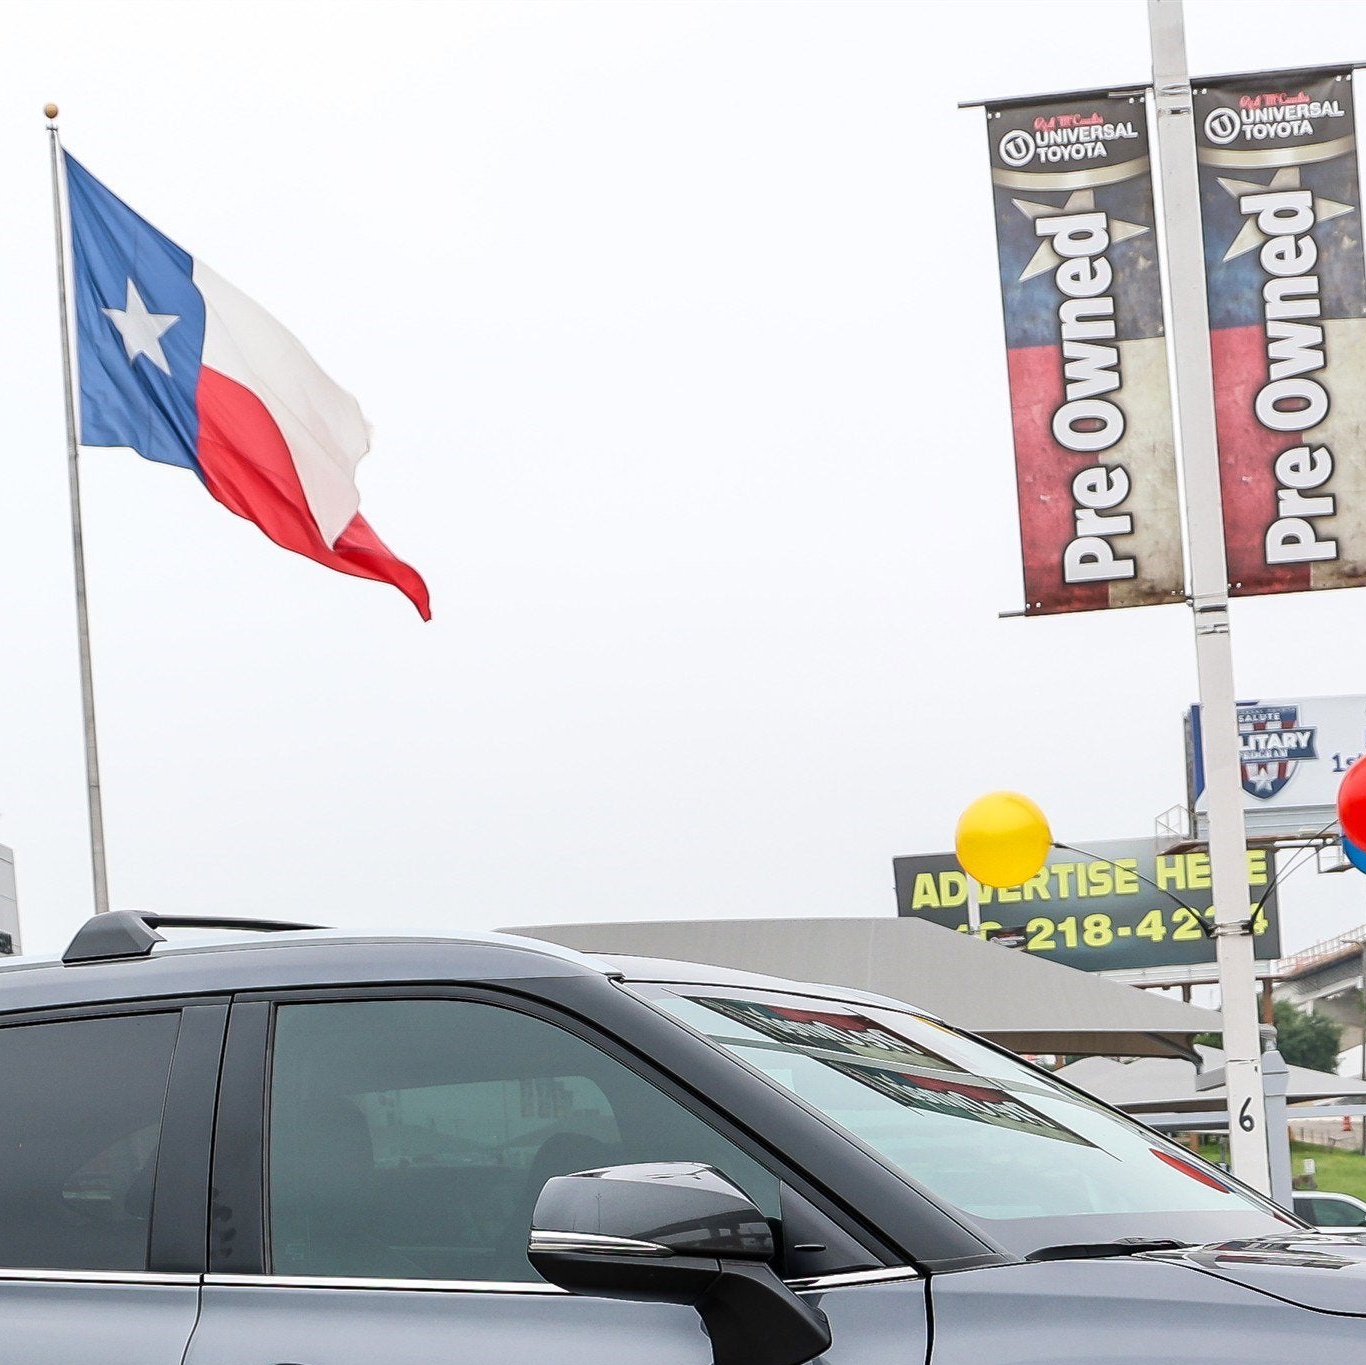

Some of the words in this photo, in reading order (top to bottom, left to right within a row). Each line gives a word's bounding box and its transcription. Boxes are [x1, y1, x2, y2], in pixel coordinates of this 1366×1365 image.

[1241, 101, 1345, 124] UNIVERSAL
[1241, 120, 1314, 141] TOYOTA
[1035, 121, 1138, 148] UNIVERSAL
[1036, 141, 1107, 164] TOYOTA
[1240, 190, 1330, 432] Owned
[1035, 211, 1126, 452] Owned
[1063, 465, 1136, 584] Pre
[1265, 445, 1338, 565] Pre
[1156, 849, 1268, 891] HEE
[1239, 1096, 1255, 1132] 6
